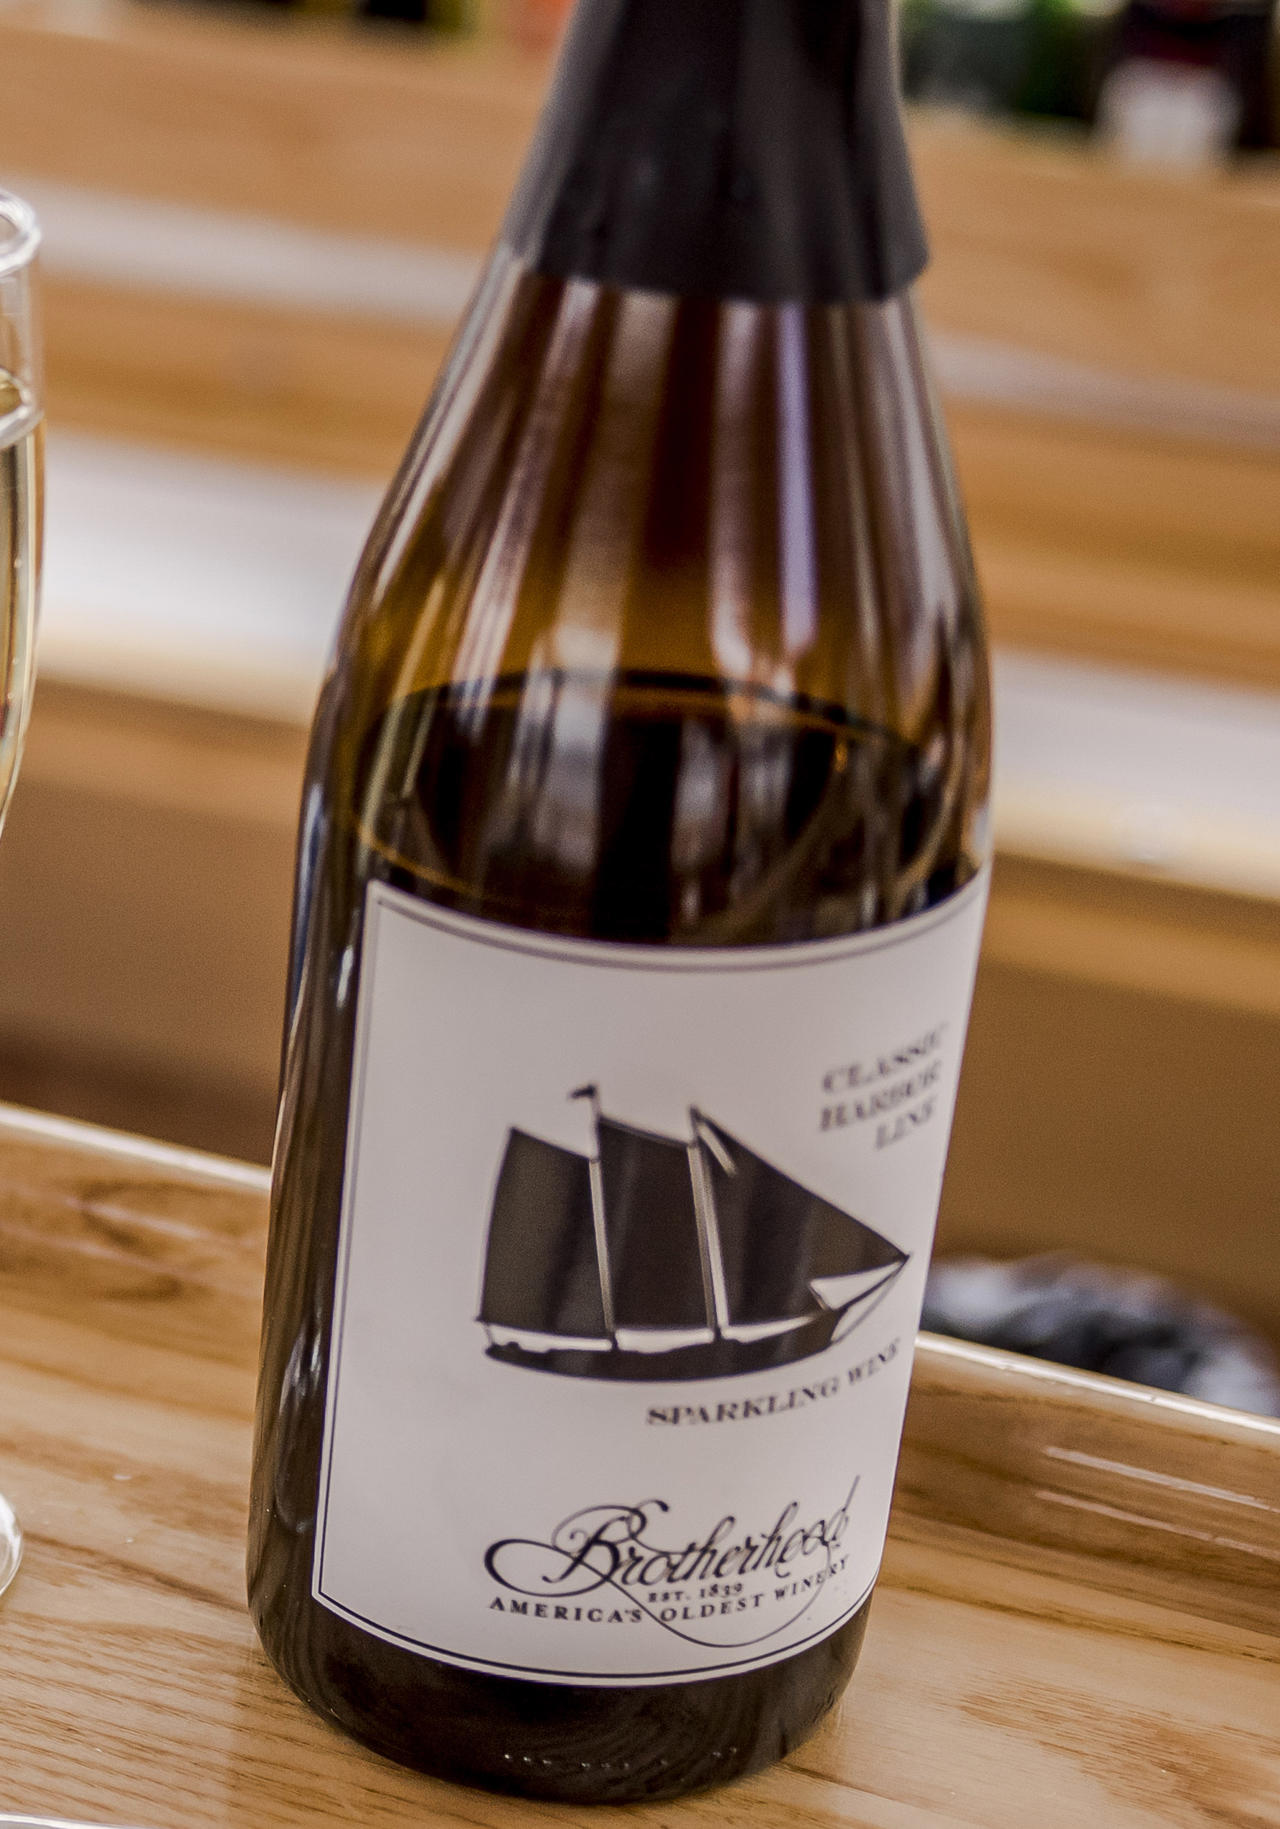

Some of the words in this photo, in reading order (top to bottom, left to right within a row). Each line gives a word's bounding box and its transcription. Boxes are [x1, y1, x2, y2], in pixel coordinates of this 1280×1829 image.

[875, 1094, 936, 1150] LINE
[647, 1376, 840, 1424] SPARKLING
[847, 1337, 900, 1386] WINE
[484, 1475, 860, 1600] Brotherhood
[489, 1596, 642, 1623] AMERICA'S
[659, 1593, 764, 1622] OLDEST
[774, 1554, 850, 1601] WINERY
